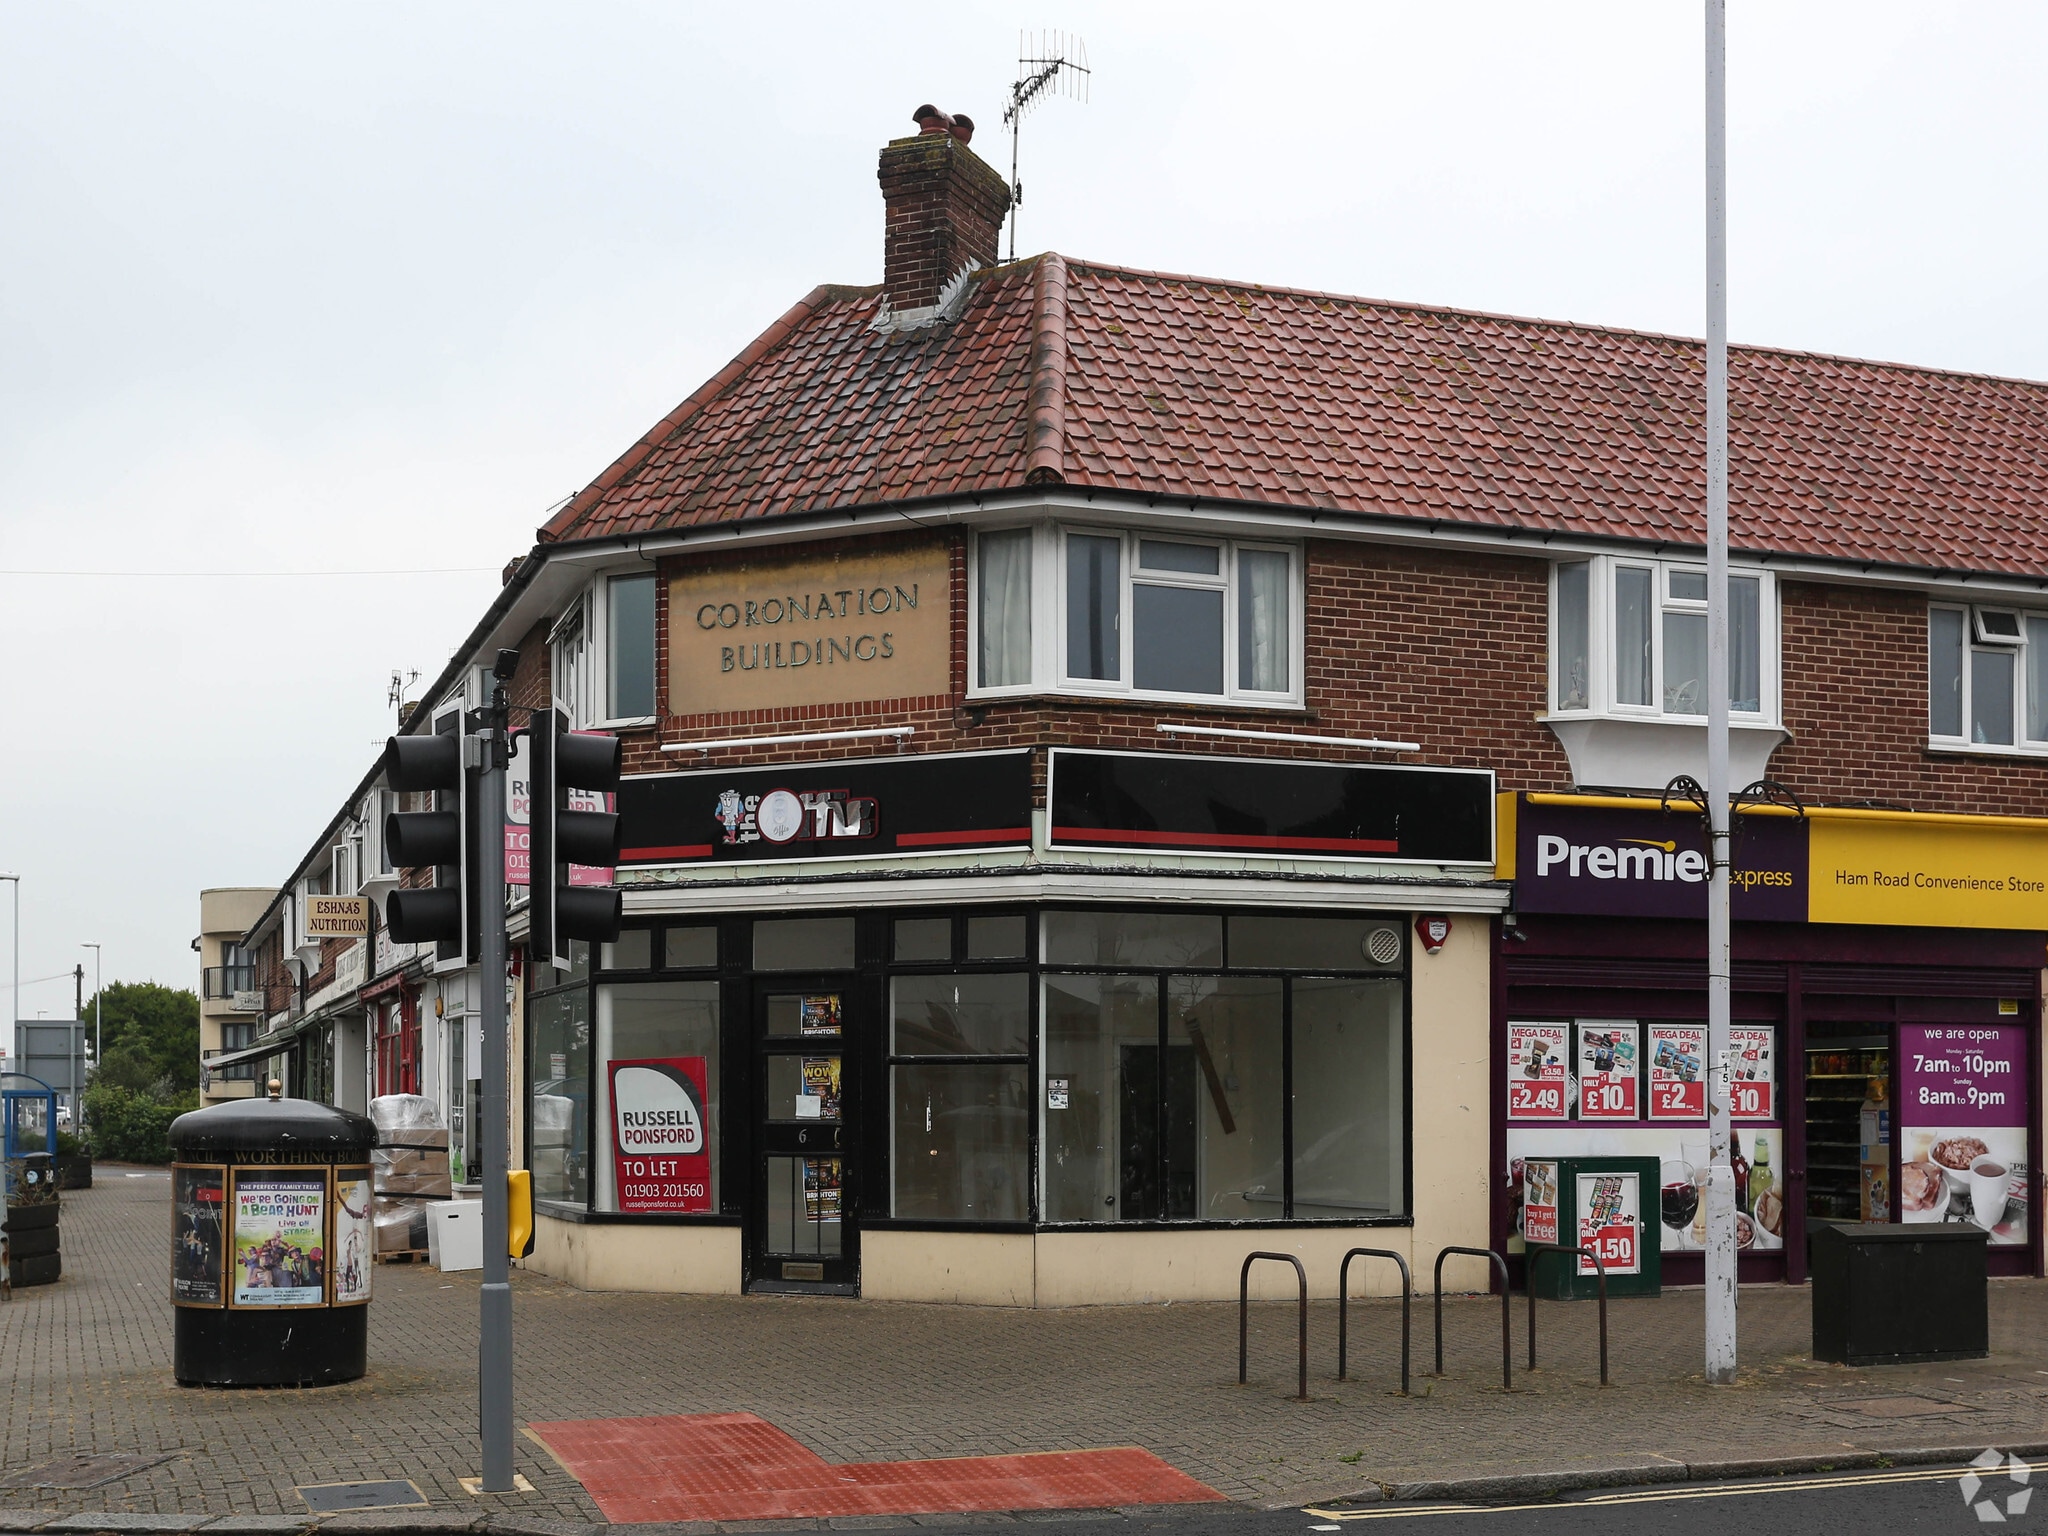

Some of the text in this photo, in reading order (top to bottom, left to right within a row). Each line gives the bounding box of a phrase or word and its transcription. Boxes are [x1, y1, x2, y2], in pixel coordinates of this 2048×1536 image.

[696, 583, 919, 630] CORONATION
[720, 632, 893, 672] BUILDINGS
[1536, 834, 1792, 892] Premie xpress
[1835, 870, 2045, 893] Ham Road Convenience Store
[310, 918, 366, 931] NUTRITION
[1511, 1028, 1563, 1038] MEGA DEAL
[1652, 1030, 1702, 1039] MEGA DEAL
[1730, 1031, 1769, 1041] EGA DEAL
[1924, 1029, 1999, 1044] we are open
[803, 1067, 832, 1078] WOW
[1913, 1055, 2010, 1078] 7am to 10pm
[1583, 1079, 1600, 1087] ONLY
[1722, 1073, 1729, 1083] 5
[1953, 1078, 1972, 1086] Sunday
[1654, 1083, 1670, 1091] ONLY
[1512, 1088, 1559, 1109] £2.49
[1587, 1084, 1625, 1111] £10
[1661, 1083, 1686, 1109] £2
[1730, 1088, 1759, 1112] £10
[1919, 1087, 2005, 1110] 8am to 9pm
[623, 1110, 693, 1127] RUSSELL
[624, 1128, 695, 1144] PONSFORD
[798, 1129, 807, 1144] 6
[235, 1150, 333, 1164] WORTHING
[623, 1161, 678, 1176] TO LET
[625, 1183, 704, 1197] 01903 201560
[241, 1205, 248, 1216] A
[286, 1204, 319, 1217] HUNT
[625, 1200, 685, 1209] russellponsford.co.uk
[1527, 1208, 1538, 1218] buy
[1542, 1211, 1553, 1220] get
[1527, 1219, 1556, 1239] free
[1581, 1229, 1598, 1237] ONLY
